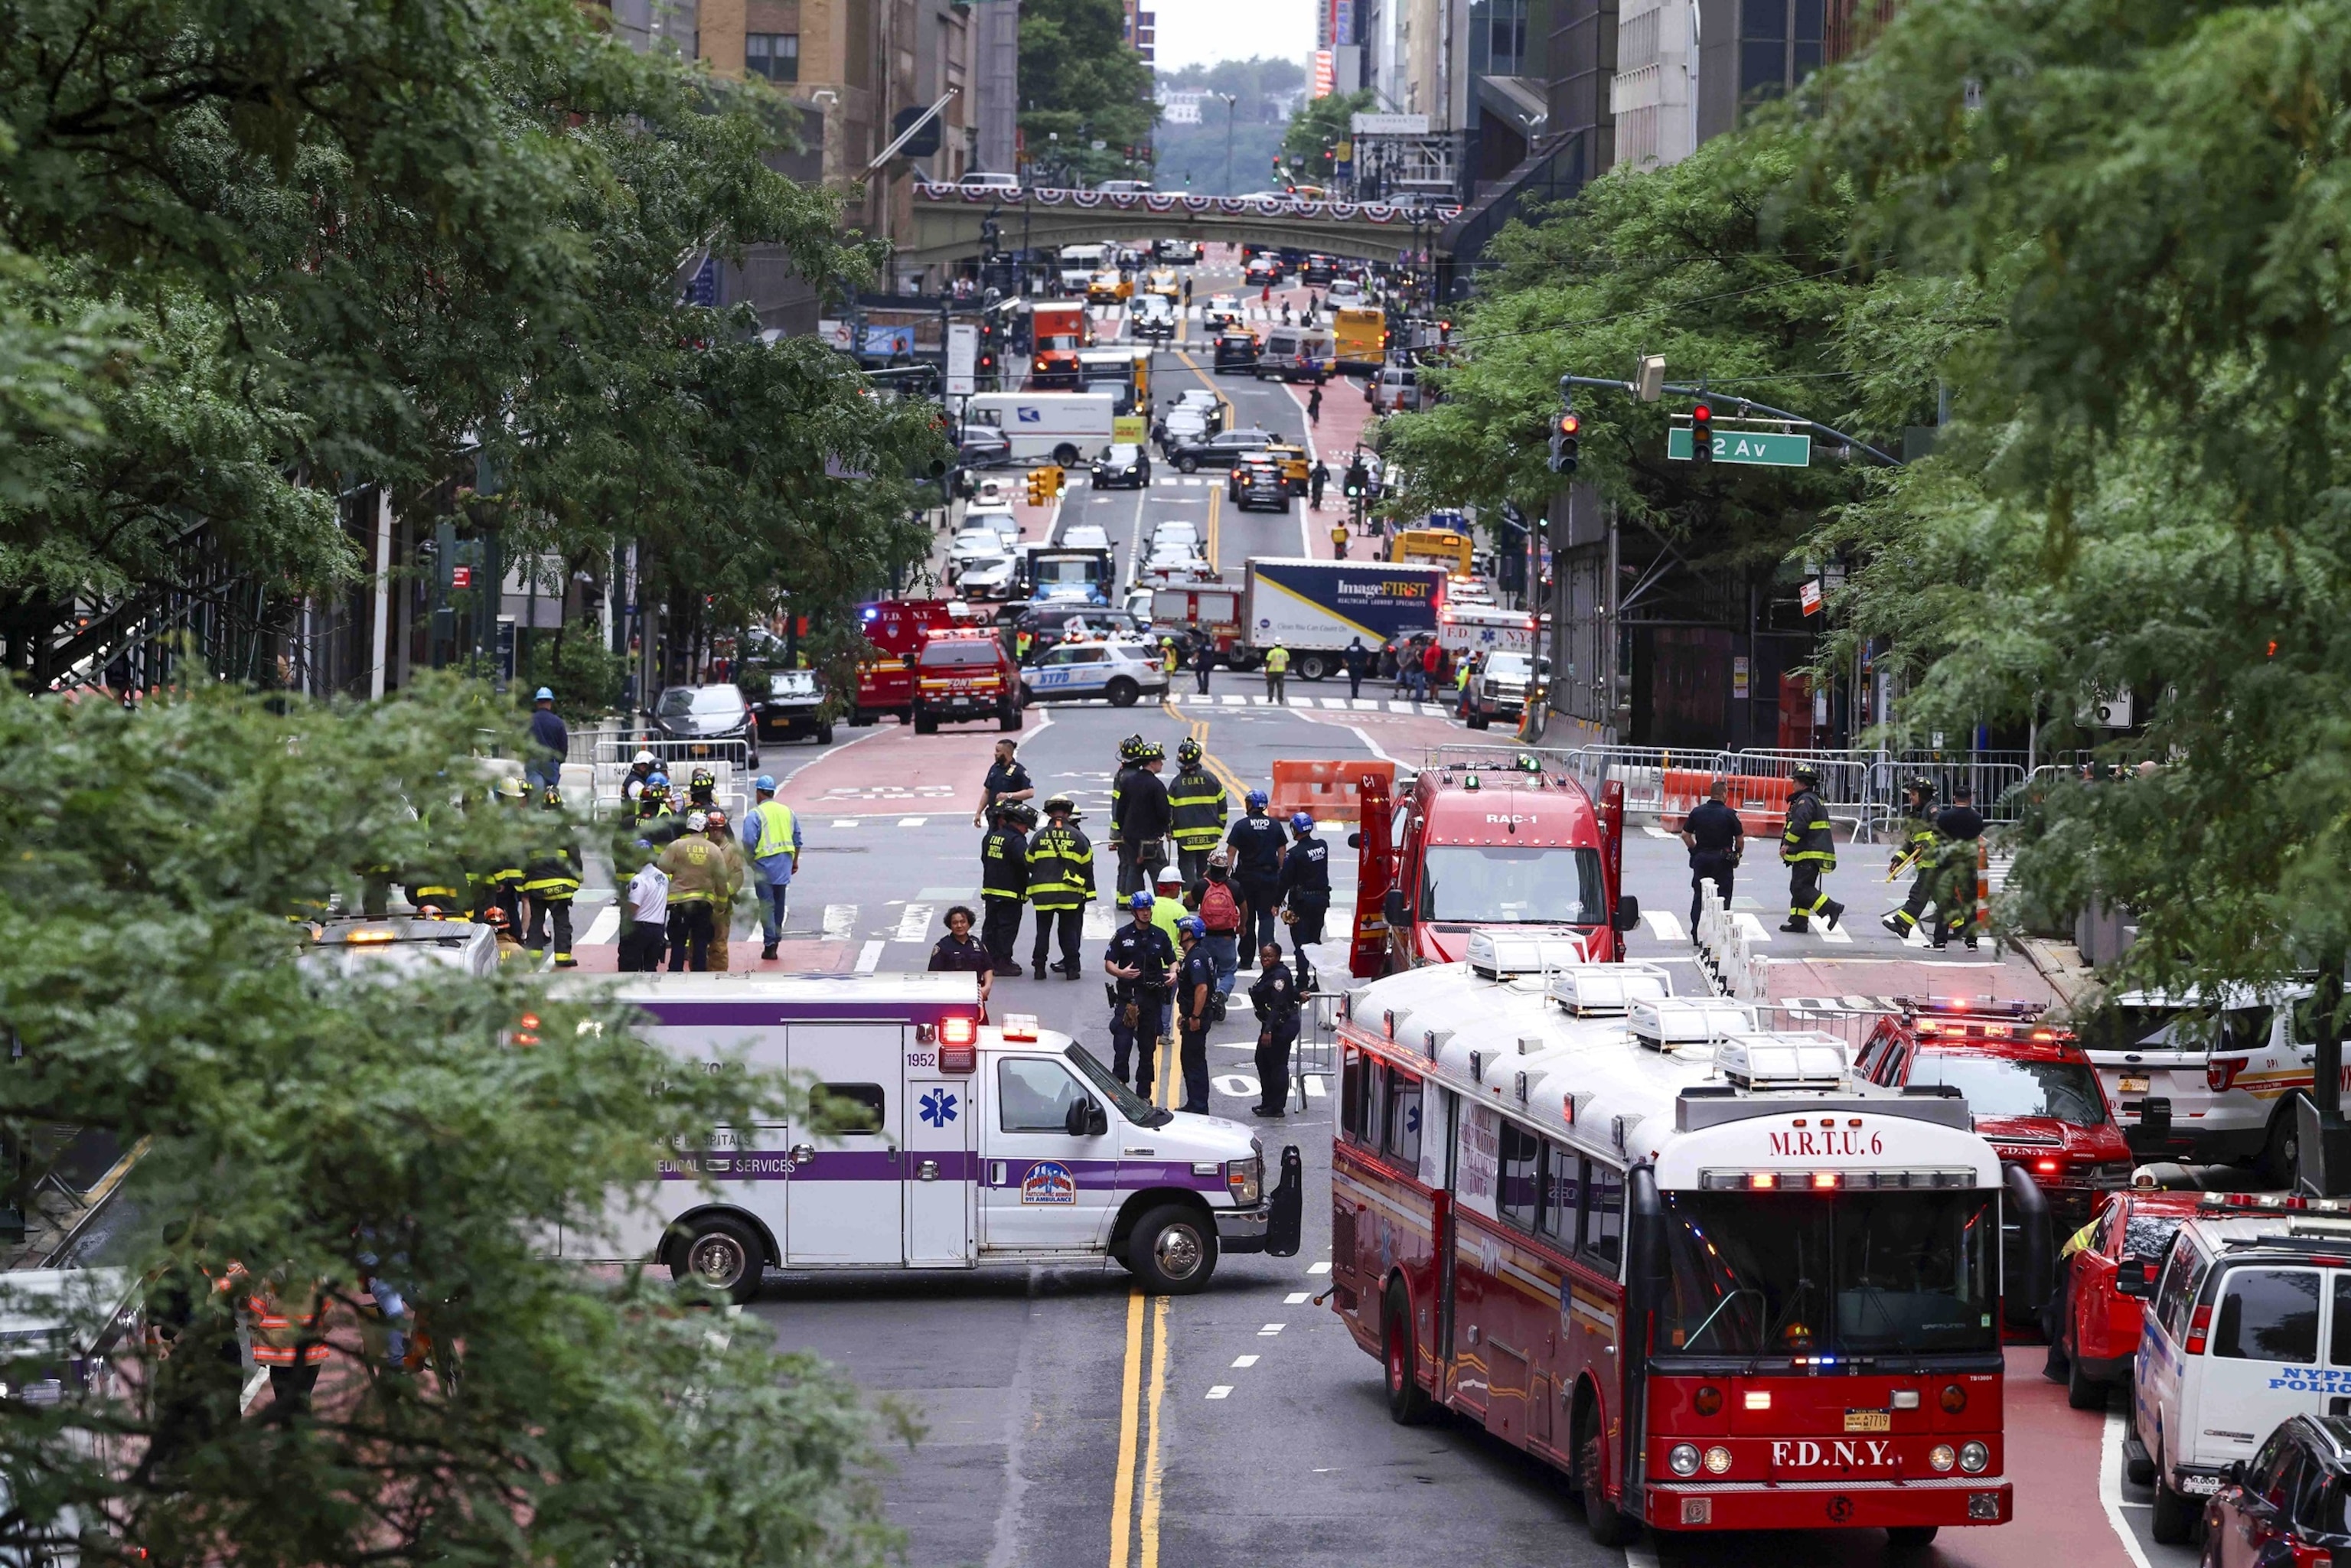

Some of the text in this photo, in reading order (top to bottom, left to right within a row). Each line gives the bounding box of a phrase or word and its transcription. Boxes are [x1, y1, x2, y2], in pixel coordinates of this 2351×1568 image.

[1713, 438, 1766, 457] 2 Av
[1338, 579, 1429, 598] ImageFIRST
[882, 612, 902, 621] F.D.
[1277, 622, 1294, 631] Clean
[1306, 624, 1319, 632] Can
[1446, 628, 1470, 638] F.D.
[947, 678, 975, 687] FDNY
[1039, 671, 1070, 685] NYPD
[1250, 818, 1270, 827] NYPD
[1486, 813, 1537, 824] RAC-1
[1306, 846, 1326, 858] NYPD
[906, 1053, 935, 1067] 1952
[1769, 1131, 1883, 1156] M.R.T.U. 6
[735, 1159, 796, 1172] SERVICES
[1479, 1237, 1502, 1278] FDNY
[1869, 1415, 1888, 1427] 7719
[1771, 1439, 1895, 1467] F.D.N.Y.
